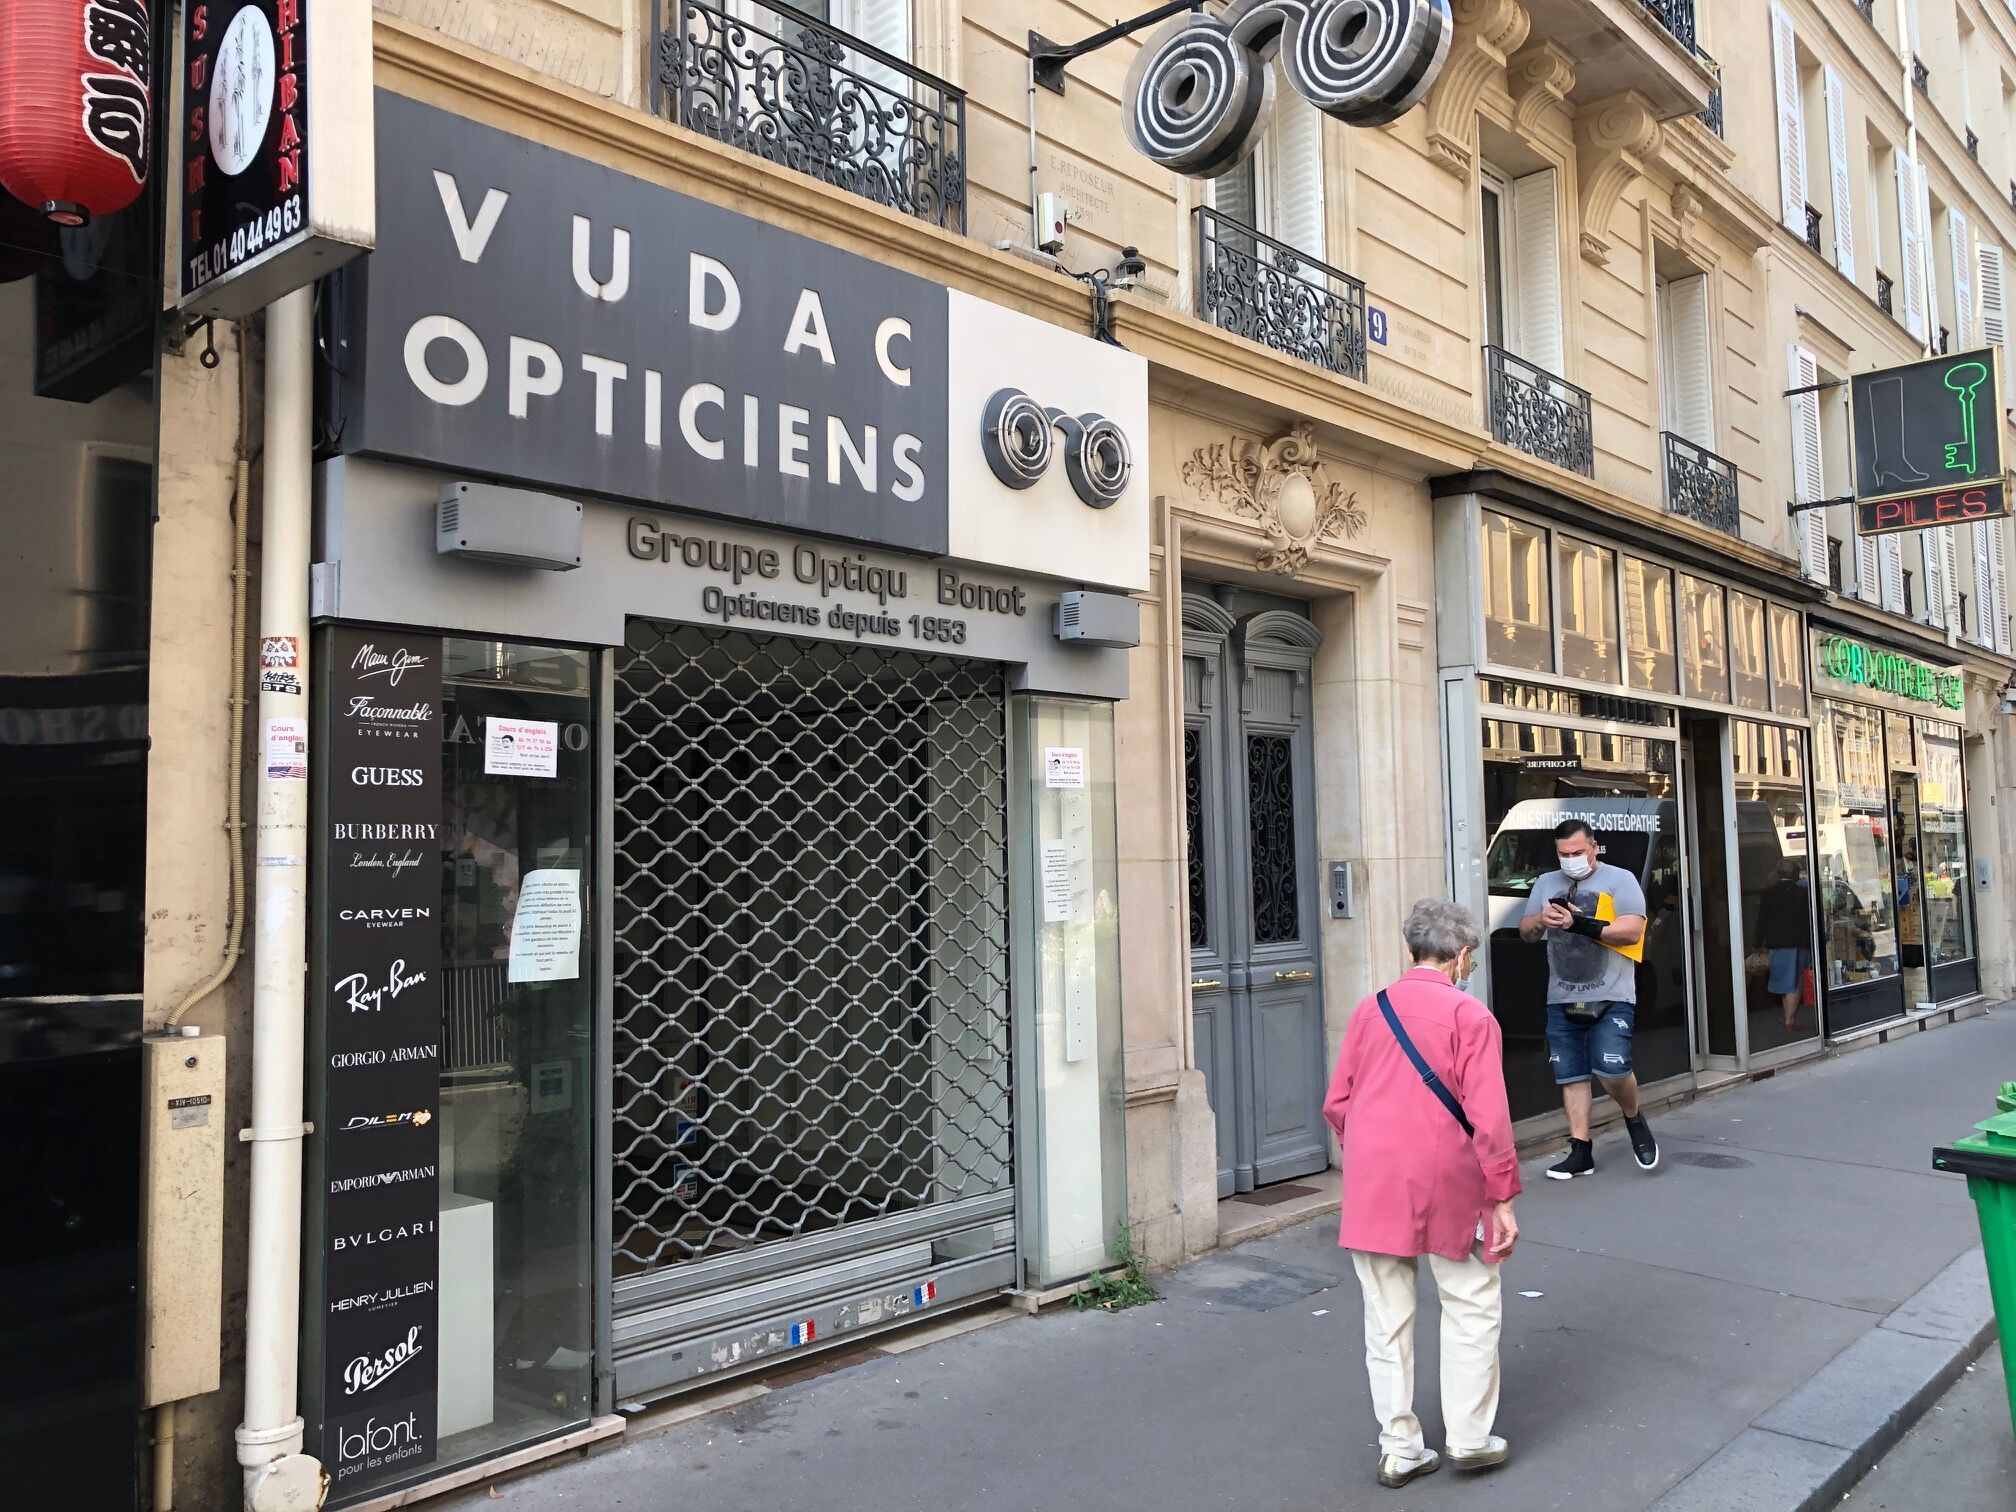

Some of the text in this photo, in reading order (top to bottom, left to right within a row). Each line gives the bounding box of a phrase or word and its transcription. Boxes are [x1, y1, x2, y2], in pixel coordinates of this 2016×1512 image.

[189, 5, 208, 243] SUSHI
[190, 195, 301, 288] TEL 01 40 44 49 63
[432, 168, 912, 388] VUDAC
[1373, 312, 1383, 339] 9
[404, 314, 925, 502] OPTICIENS
[1875, 489, 1988, 528] PILES
[628, 515, 1026, 616] Groupe Optiqu Bonot
[702, 586, 967, 645] Opticiens depuis 1953
[344, 696, 433, 722] Façonnable
[358, 728, 419, 738] EYEWEAR
[498, 725, 516, 733] Cours
[351, 766, 424, 787] GUESS
[334, 823, 438, 840] BURBERRY
[386, 849, 423, 879] England
[339, 907, 430, 921] CARVEN
[366, 920, 404, 929] EYEWEAR
[331, 1044, 438, 1069] GIORGIO ARMANI
[330, 1165, 435, 1193] EMPORIO ARMANI
[333, 1219, 435, 1251] BVLGARI
[330, 1280, 434, 1313] HENRY JULLIEN
[344, 1325, 422, 1395] Persol
[338, 1443, 423, 1481] pour les enfants
